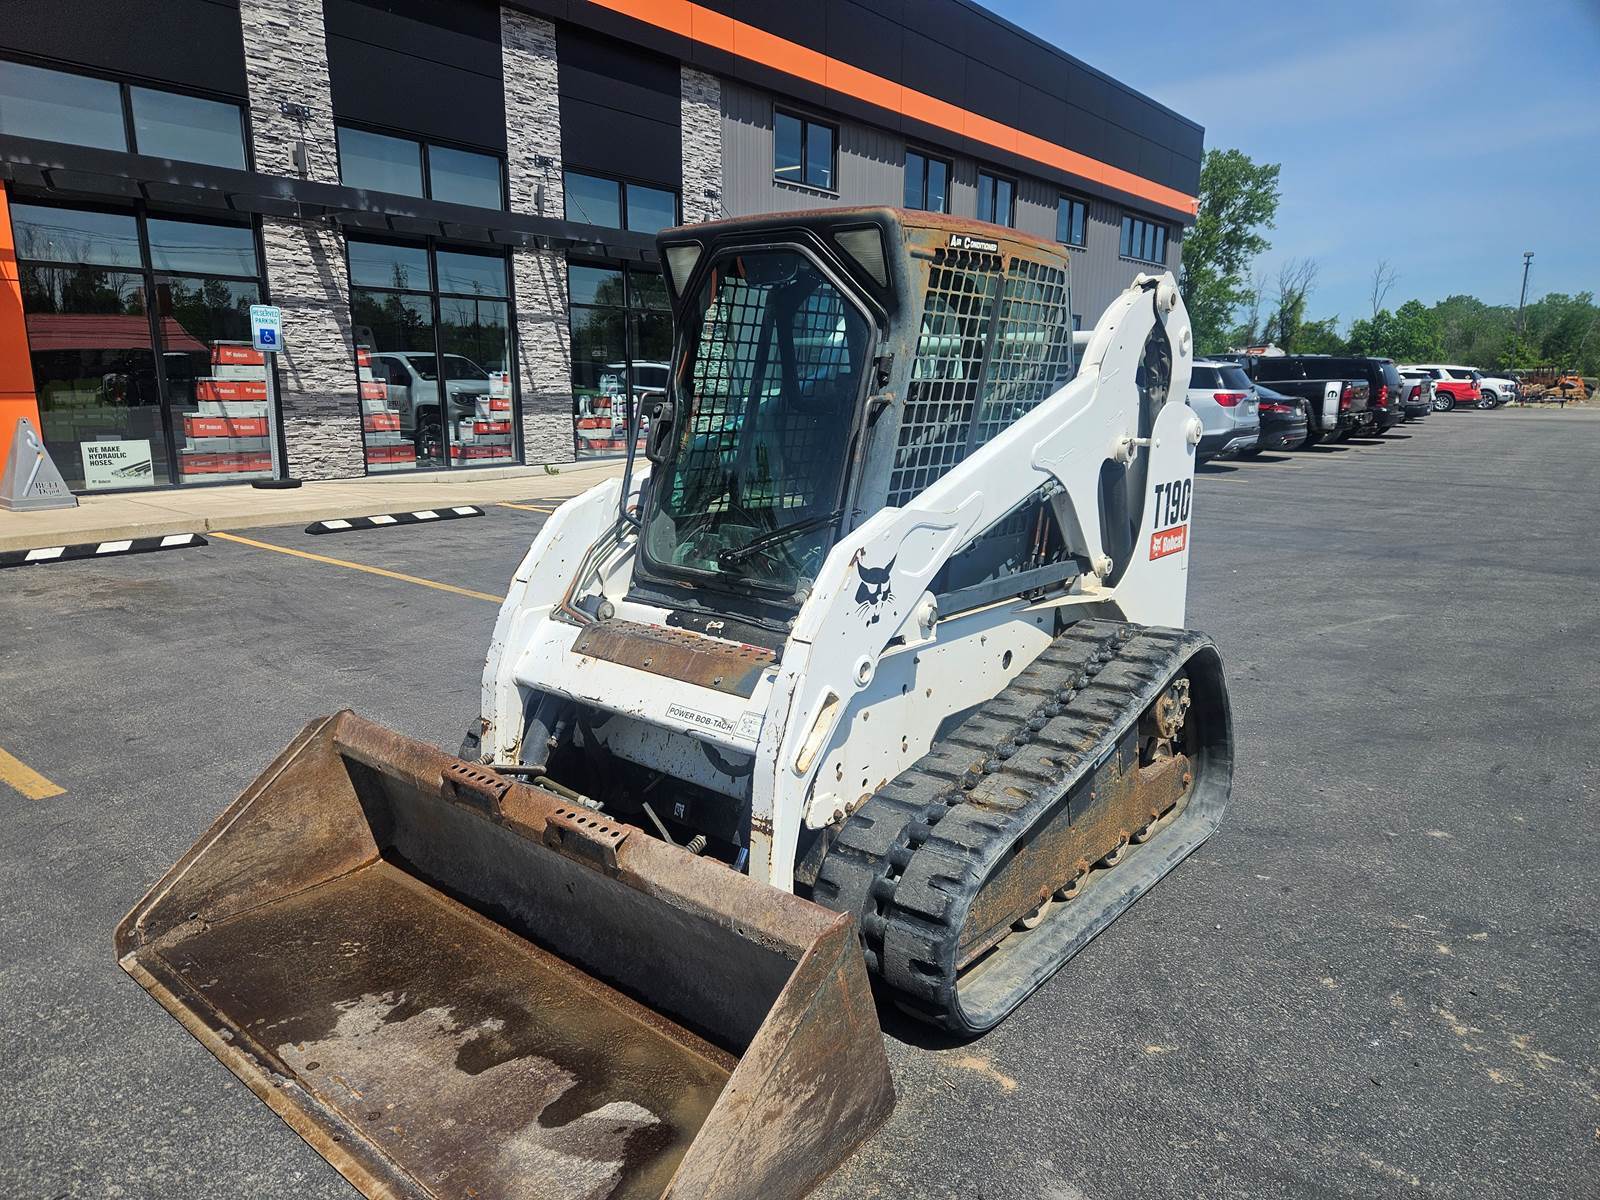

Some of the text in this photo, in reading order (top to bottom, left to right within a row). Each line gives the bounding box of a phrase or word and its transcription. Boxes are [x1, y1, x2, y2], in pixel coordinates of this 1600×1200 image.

[252, 309, 279, 318] RESERVED
[255, 317, 278, 325] PARKING
[89, 452, 127, 460] HYDRAULIC
[1154, 478, 1191, 529] T190
[1162, 534, 1183, 553] Bobcat
[669, 707, 733, 731] POWER BOB-TACH
